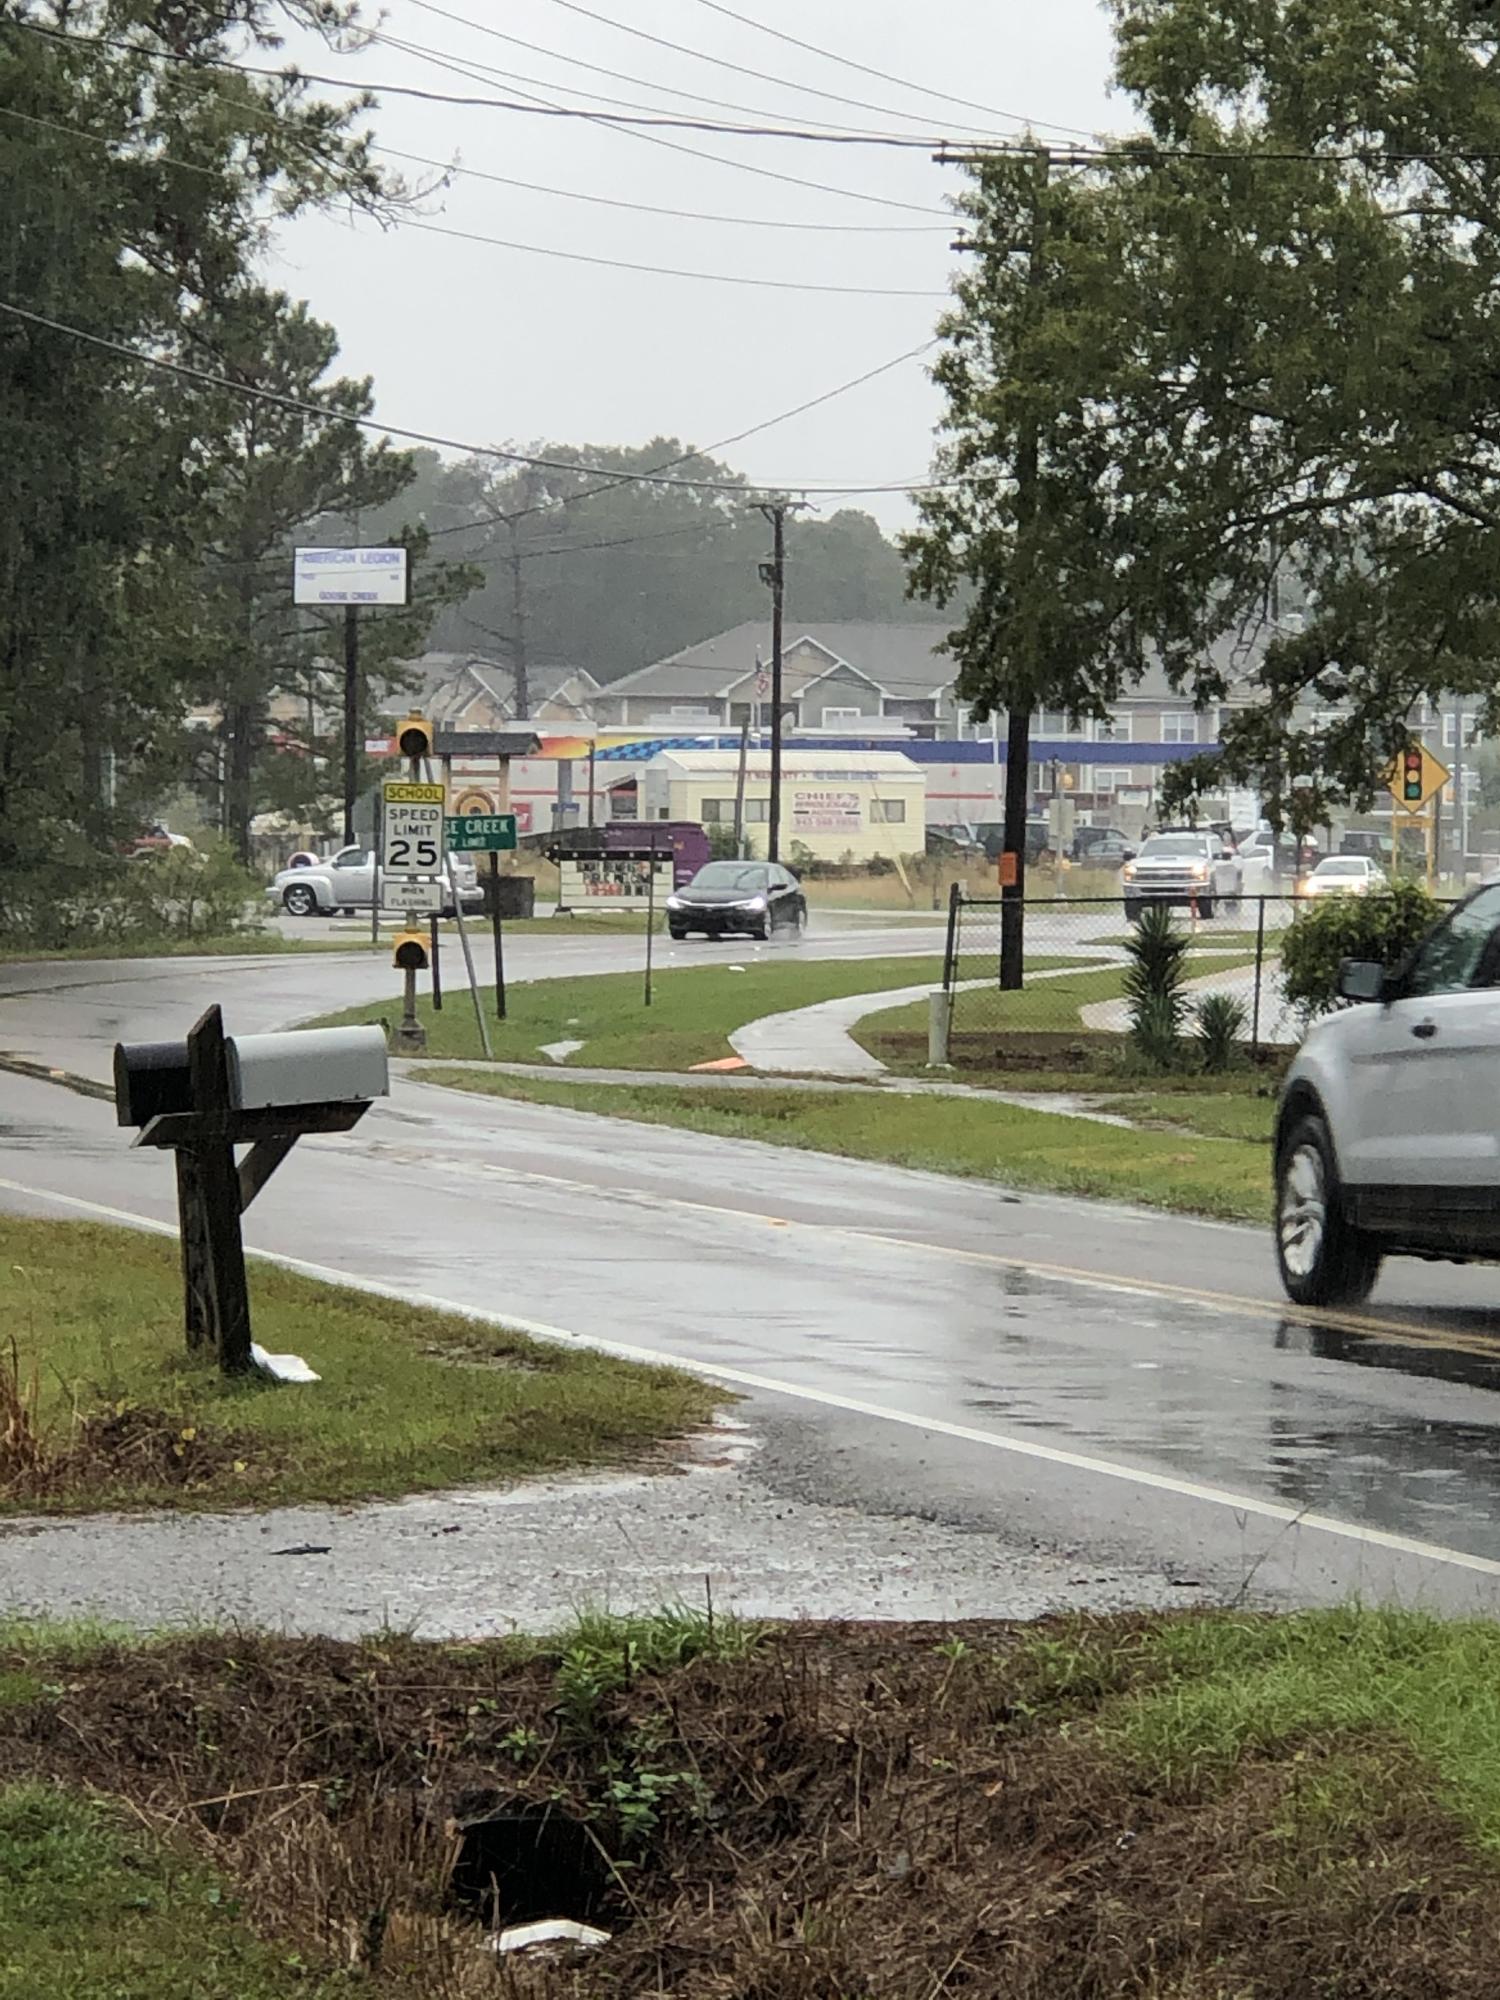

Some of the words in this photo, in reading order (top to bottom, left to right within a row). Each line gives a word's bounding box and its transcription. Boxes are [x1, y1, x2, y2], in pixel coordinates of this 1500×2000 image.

[388, 787, 440, 799] SCHOOL
[389, 809, 439, 821] SPEED
[393, 824, 433, 836] LIMIT
[465, 819, 510, 834] CREEK
[389, 840, 437, 867] 25
[401, 886, 425, 895] WHEN
[391, 898, 433, 907] FLASHING
